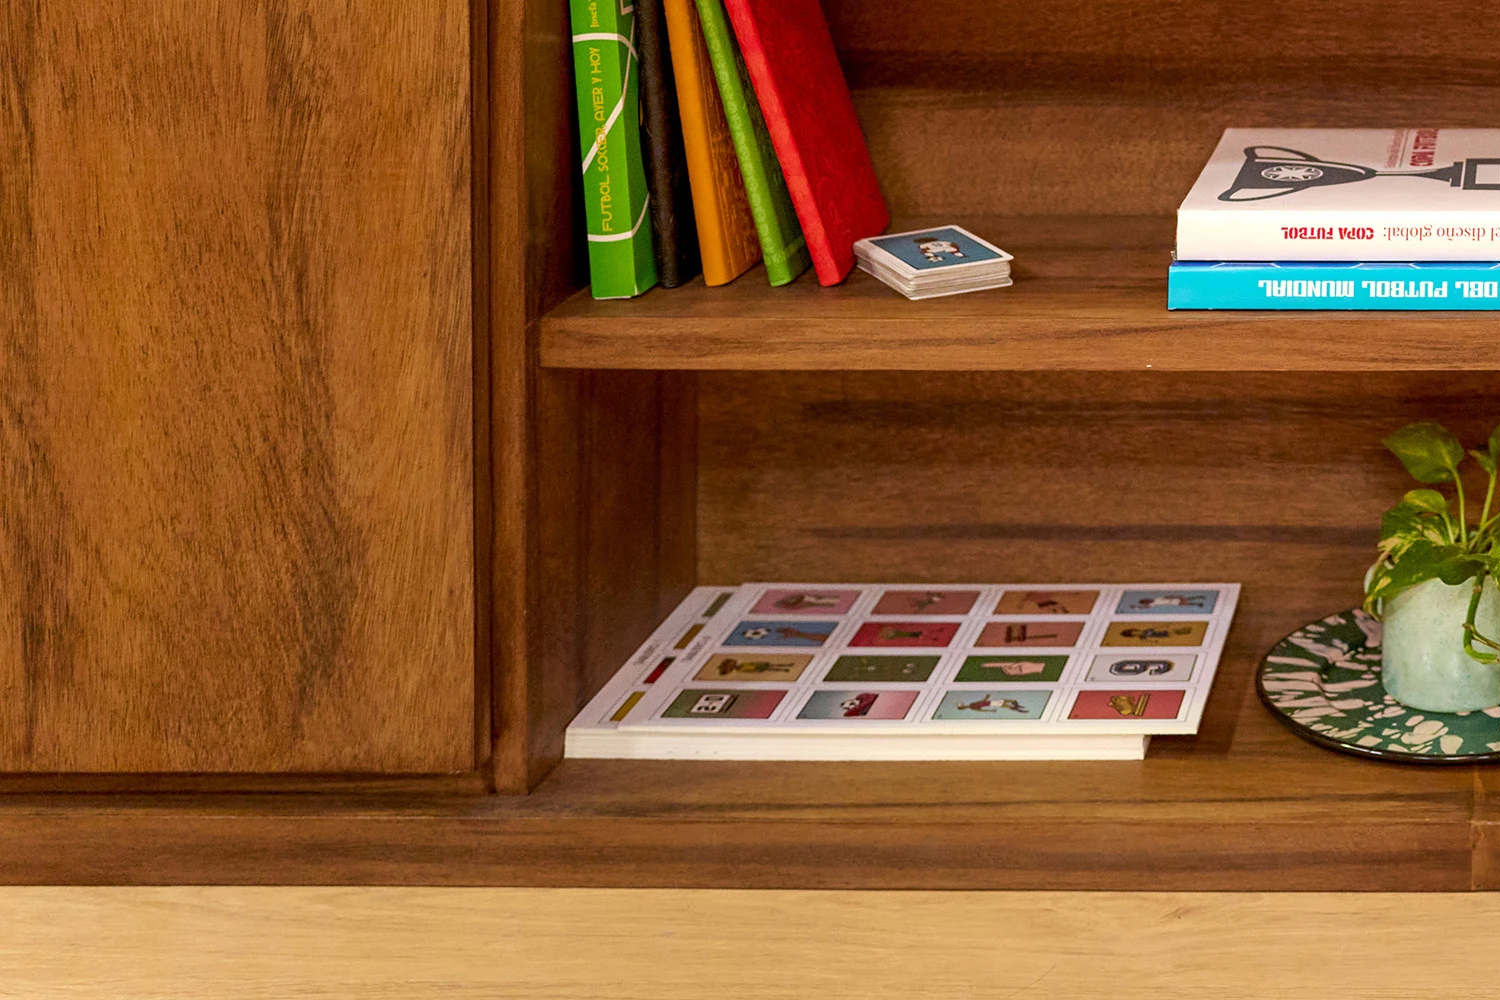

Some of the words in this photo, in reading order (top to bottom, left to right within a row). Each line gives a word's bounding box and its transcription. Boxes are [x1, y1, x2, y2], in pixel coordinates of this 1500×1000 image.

[589, 47, 602, 74] HOY
[592, 87, 605, 122] AYER
[600, 175, 613, 232] FUTBOL
[1280, 226, 1334, 240] FUTBOL
[1338, 226, 1375, 240] COPA
[1383, 225, 1433, 241] global:
[1436, 226, 1486, 241] diseño
[1257, 279, 1355, 298] MUNDIAL
[1361, 280, 1448, 298] FUTBOL
[1454, 280, 1499, 299] DEL
